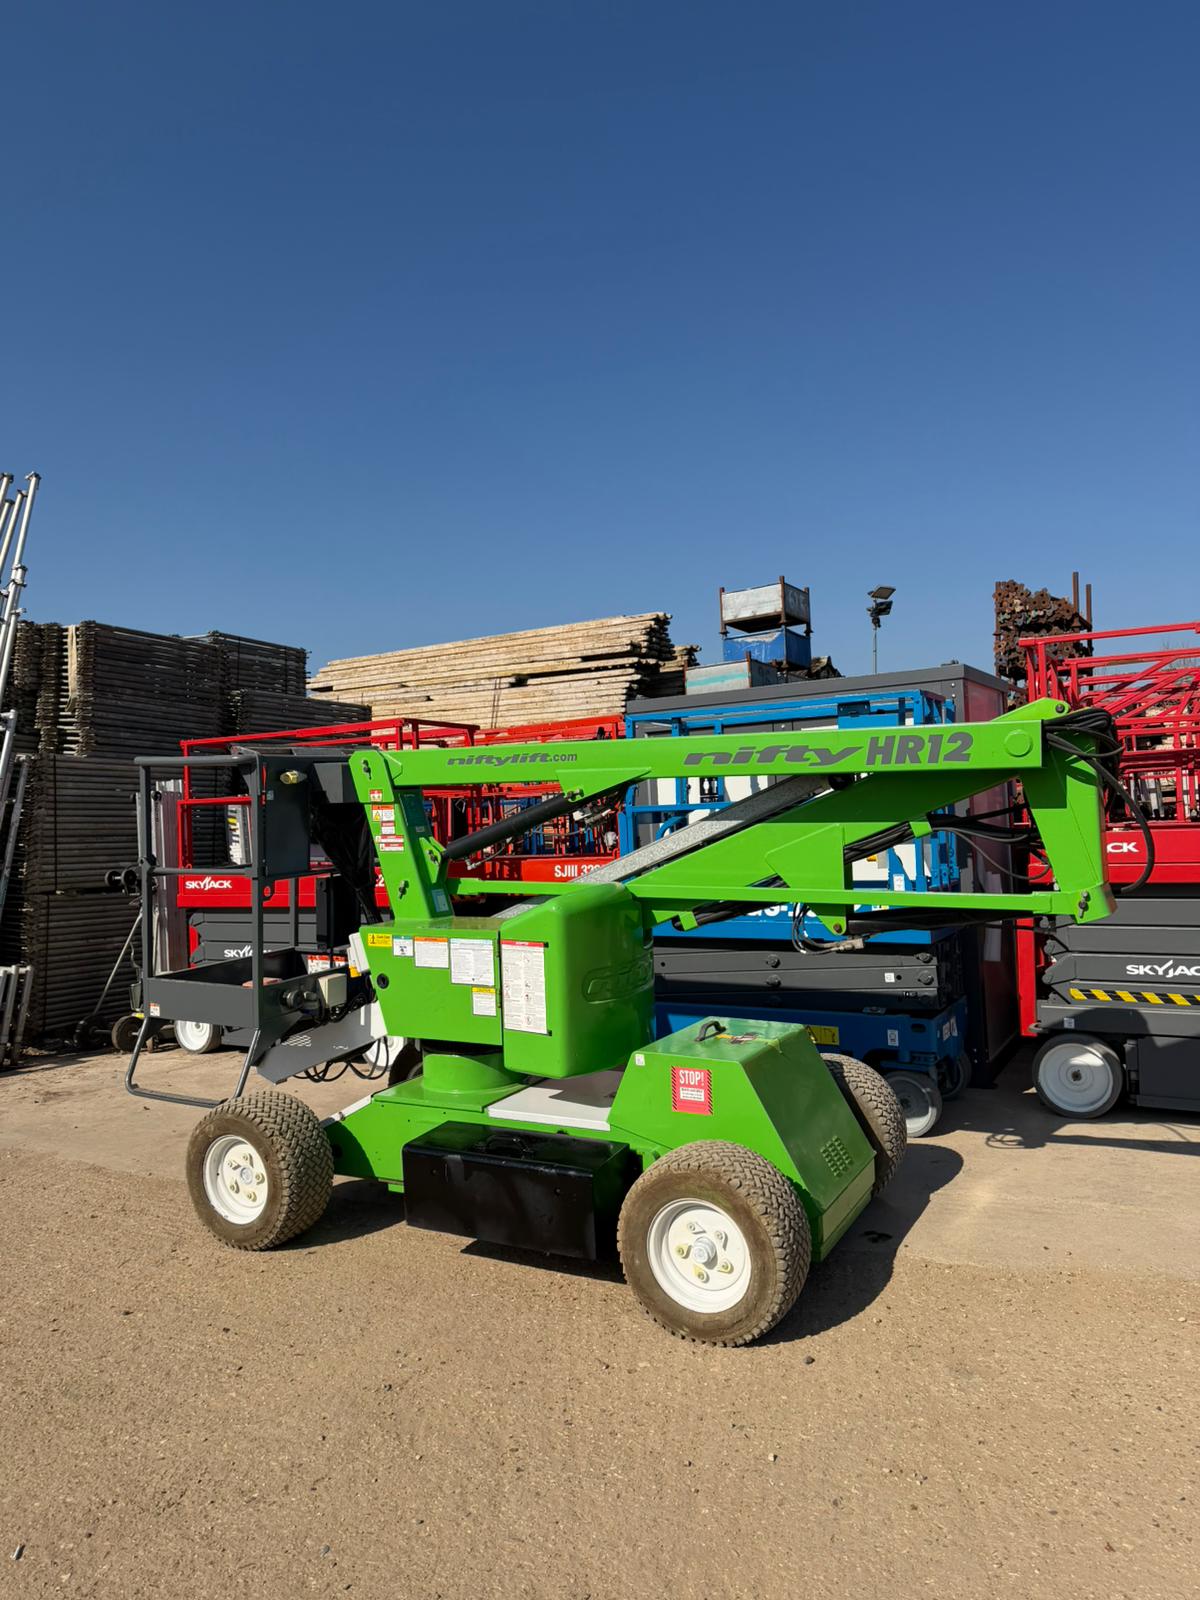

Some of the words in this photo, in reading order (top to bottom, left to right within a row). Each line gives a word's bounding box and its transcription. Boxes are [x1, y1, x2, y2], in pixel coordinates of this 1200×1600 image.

[684, 744, 864, 767] nifty
[864, 731, 974, 766] HR12
[447, 753, 577, 766] niftylift.com
[679, 1069, 705, 1086] STOP!
